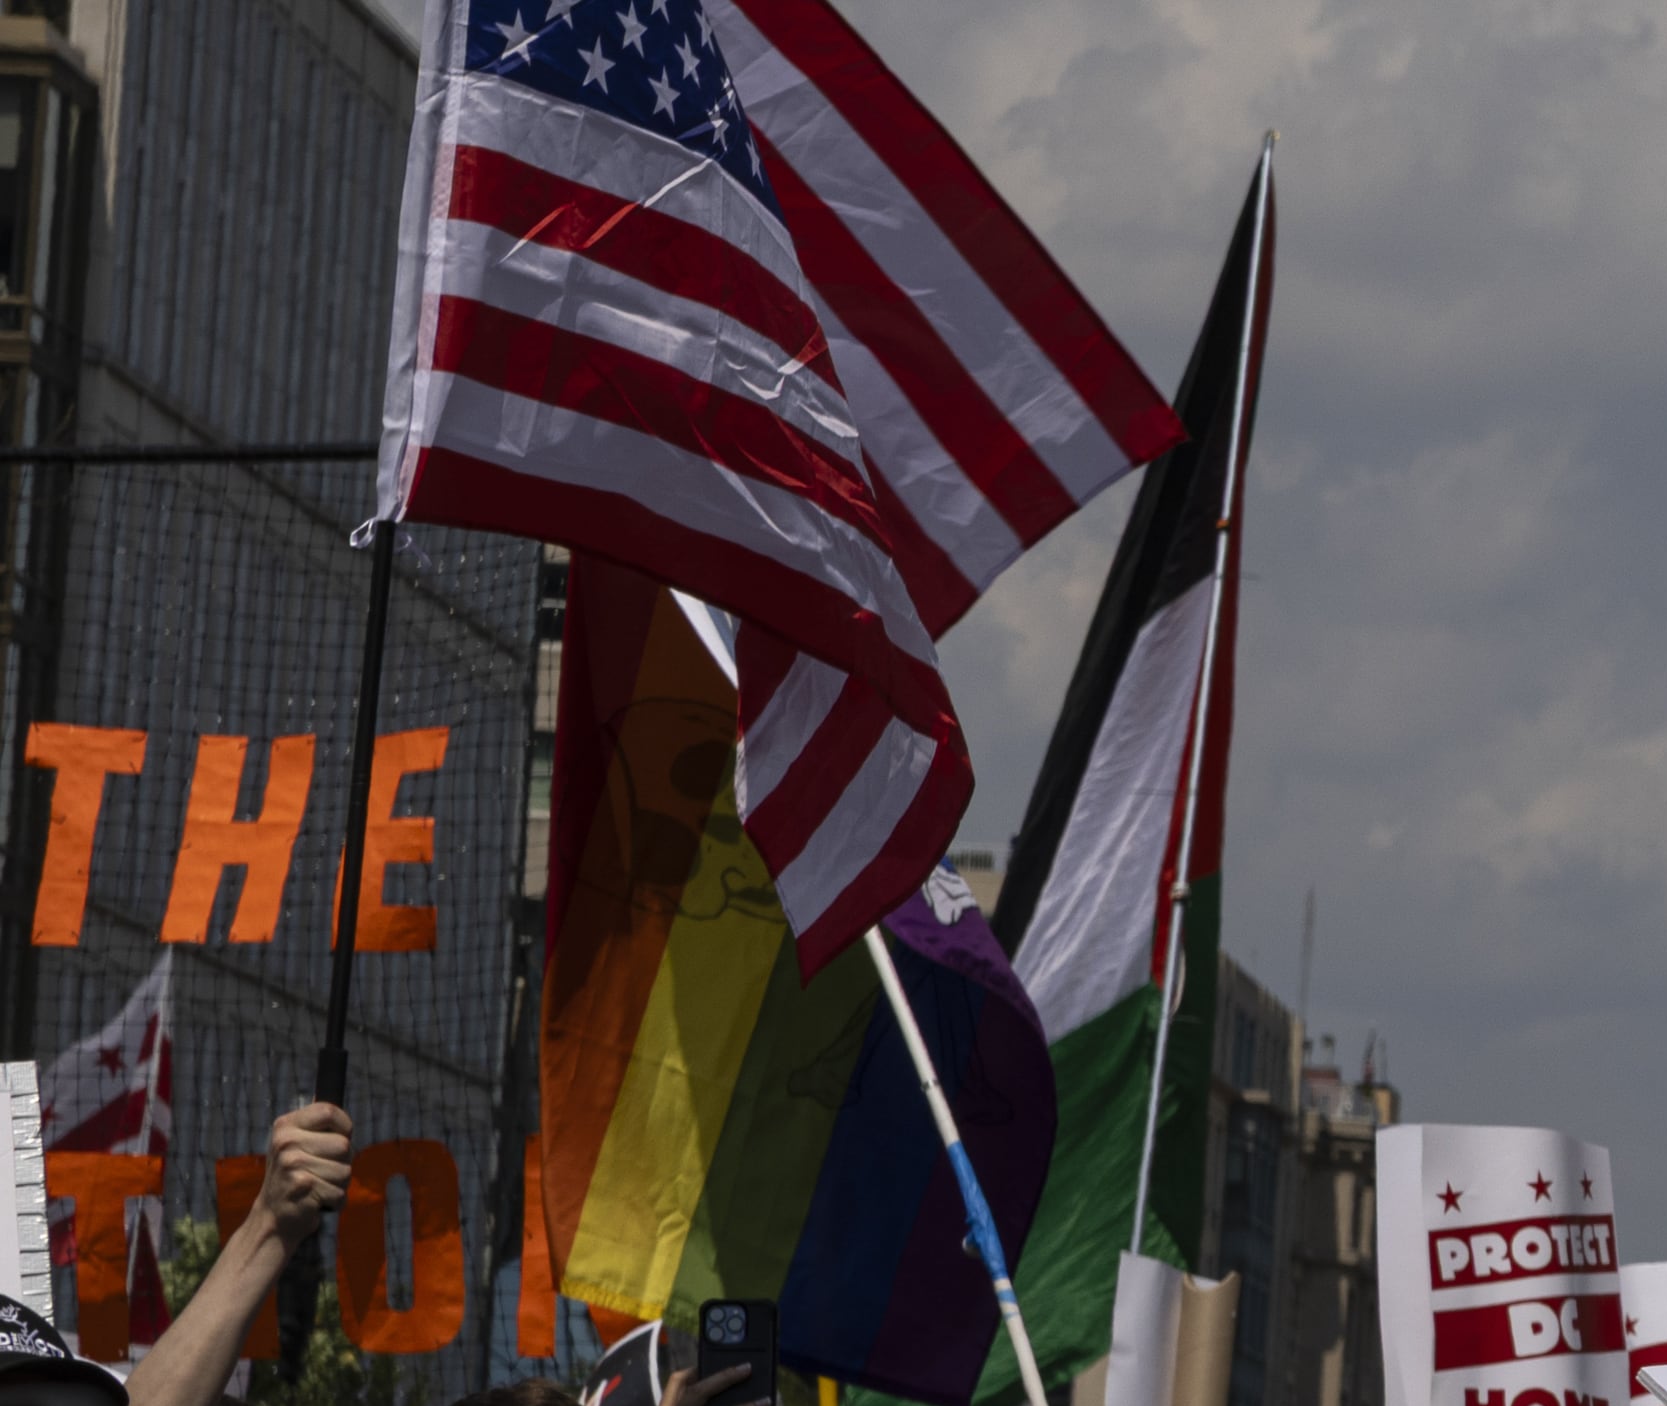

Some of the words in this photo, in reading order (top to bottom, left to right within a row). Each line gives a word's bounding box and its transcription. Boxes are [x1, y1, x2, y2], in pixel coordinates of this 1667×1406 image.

[24, 721, 450, 953] THE
[1437, 1224, 1613, 1282] PROTECT
[1508, 1298, 1583, 1358] DC
